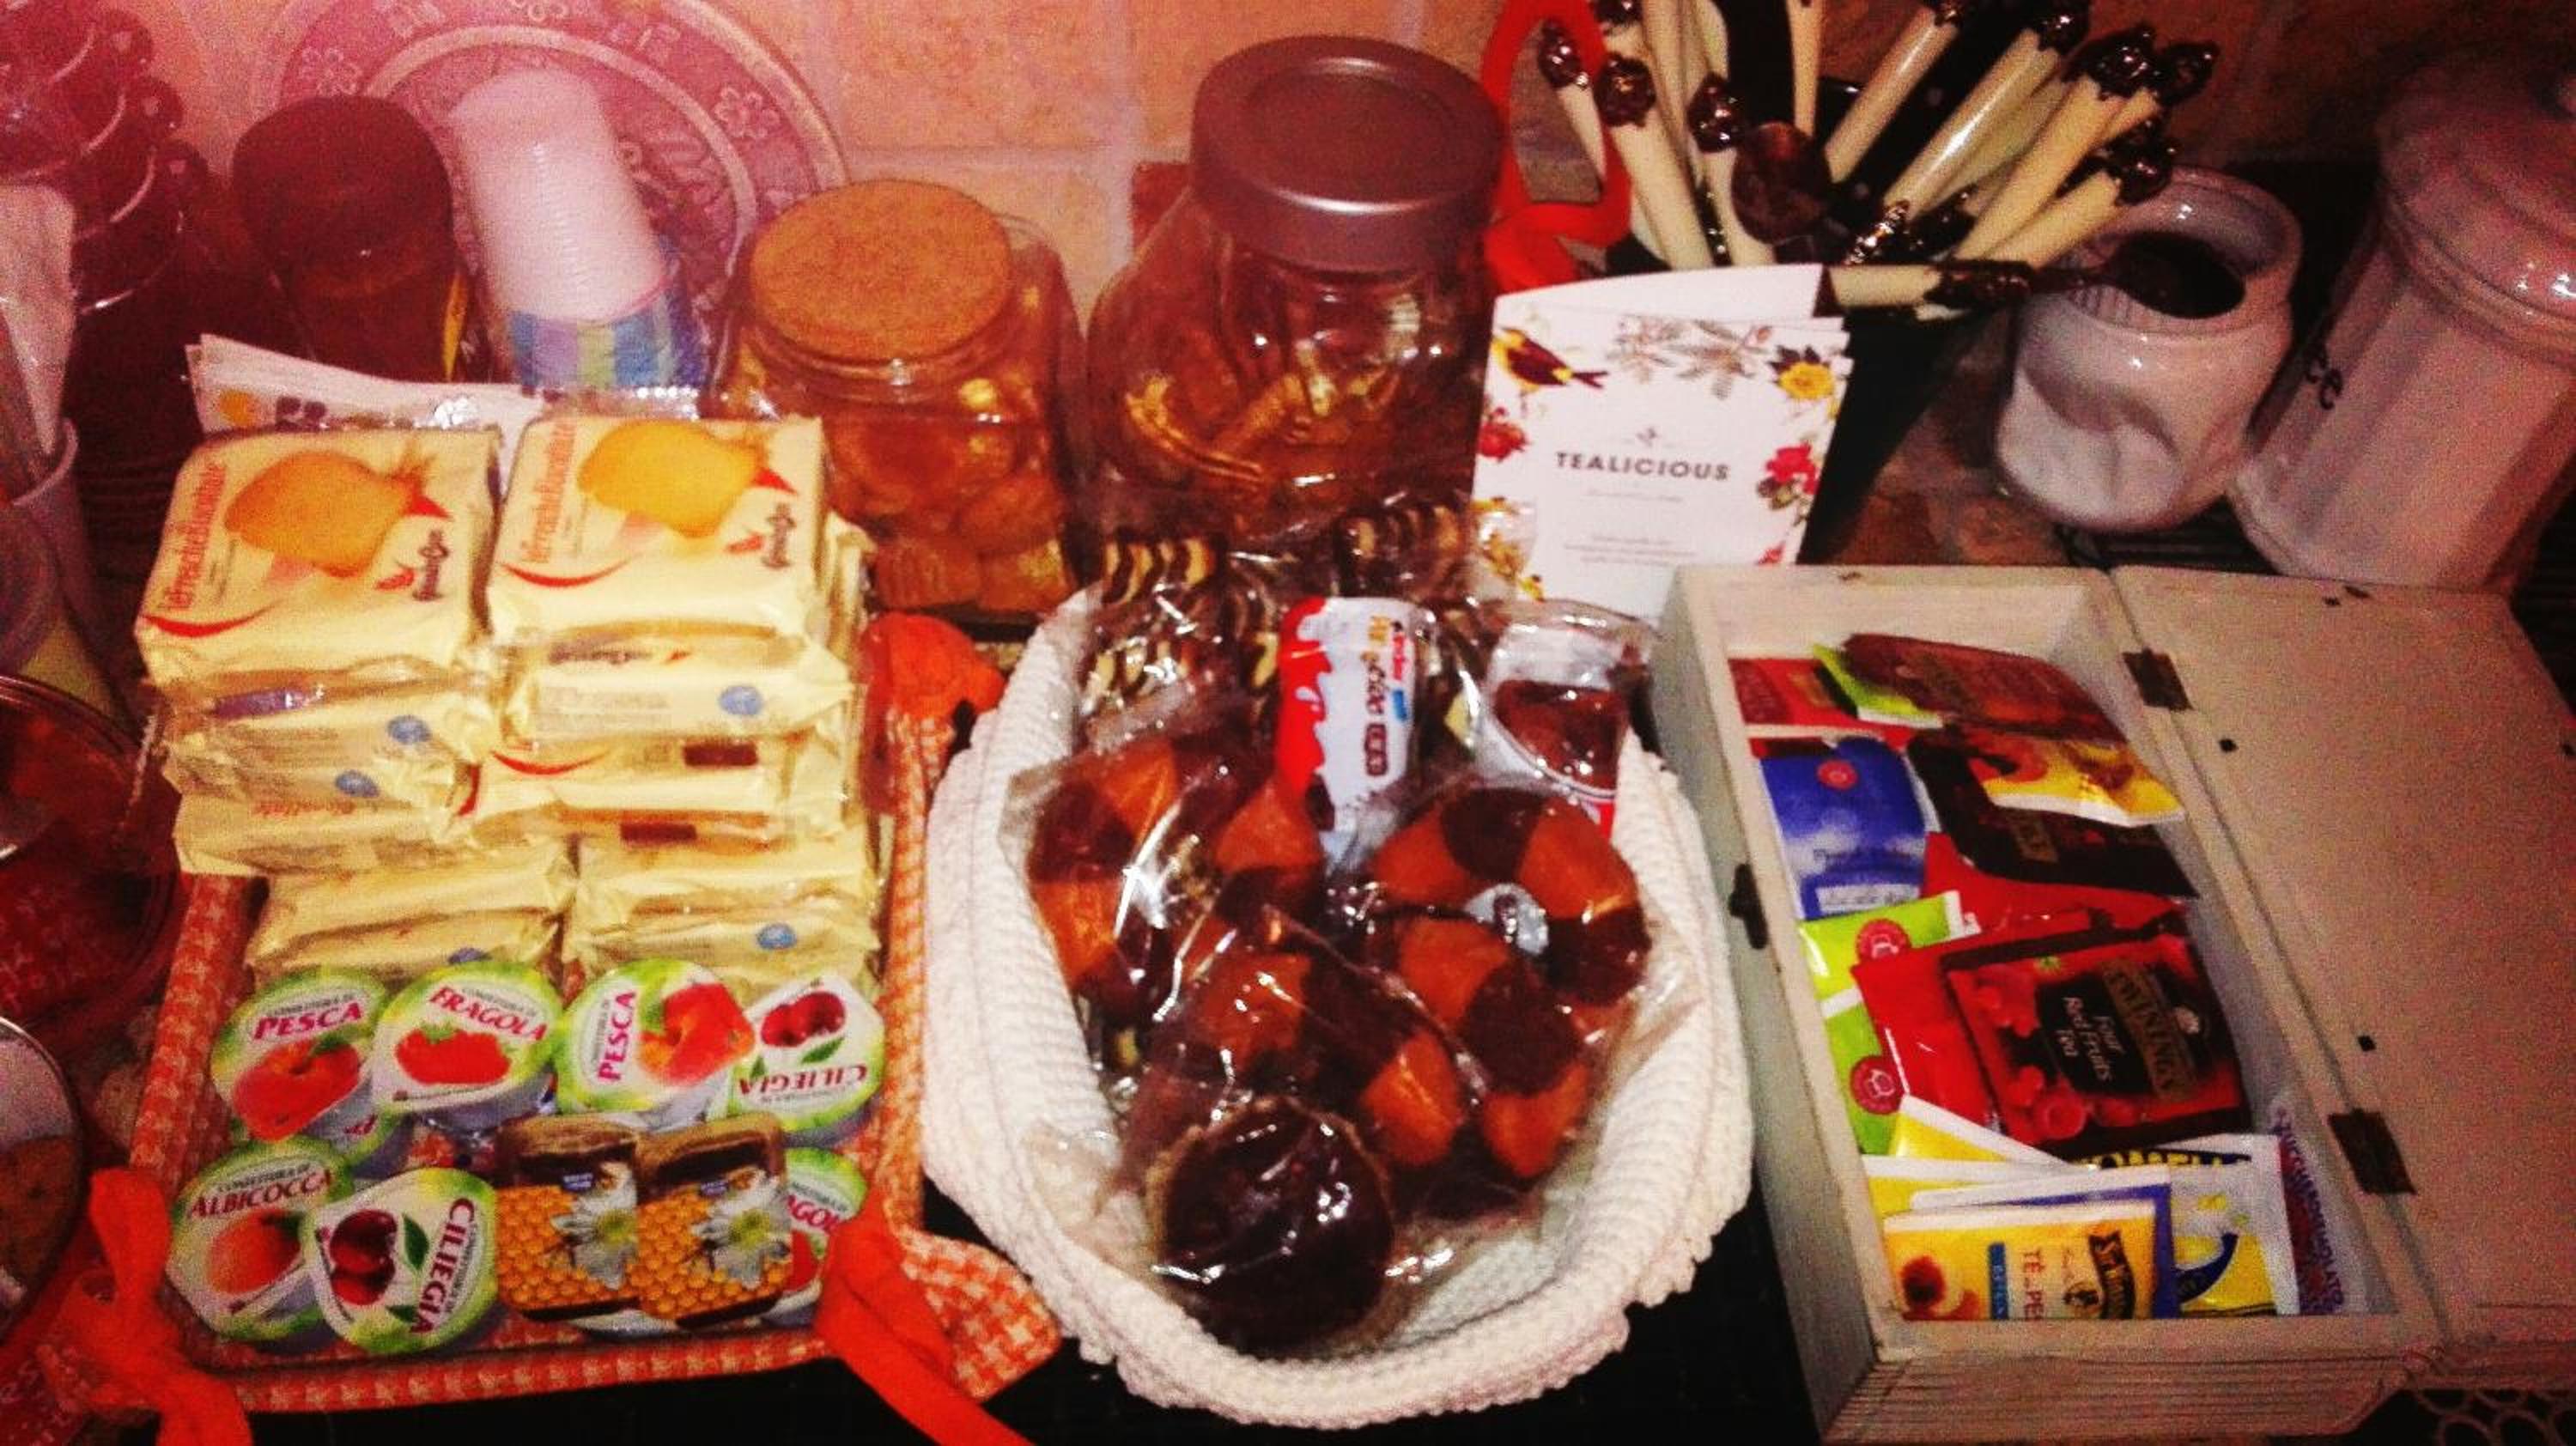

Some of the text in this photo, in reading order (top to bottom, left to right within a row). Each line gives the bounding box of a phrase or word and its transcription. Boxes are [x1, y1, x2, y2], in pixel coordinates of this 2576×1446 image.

[1556, 452, 1729, 481] TEALICIOUS
[254, 1002, 363, 1040] PESCA
[429, 986, 548, 1041] FRAGOLA
[597, 992, 636, 1081] PESCA
[738, 1063, 868, 1095] CILIEGIA
[191, 1169, 332, 1218] ALBICOCCA
[410, 1198, 476, 1333] CILIEGIA
